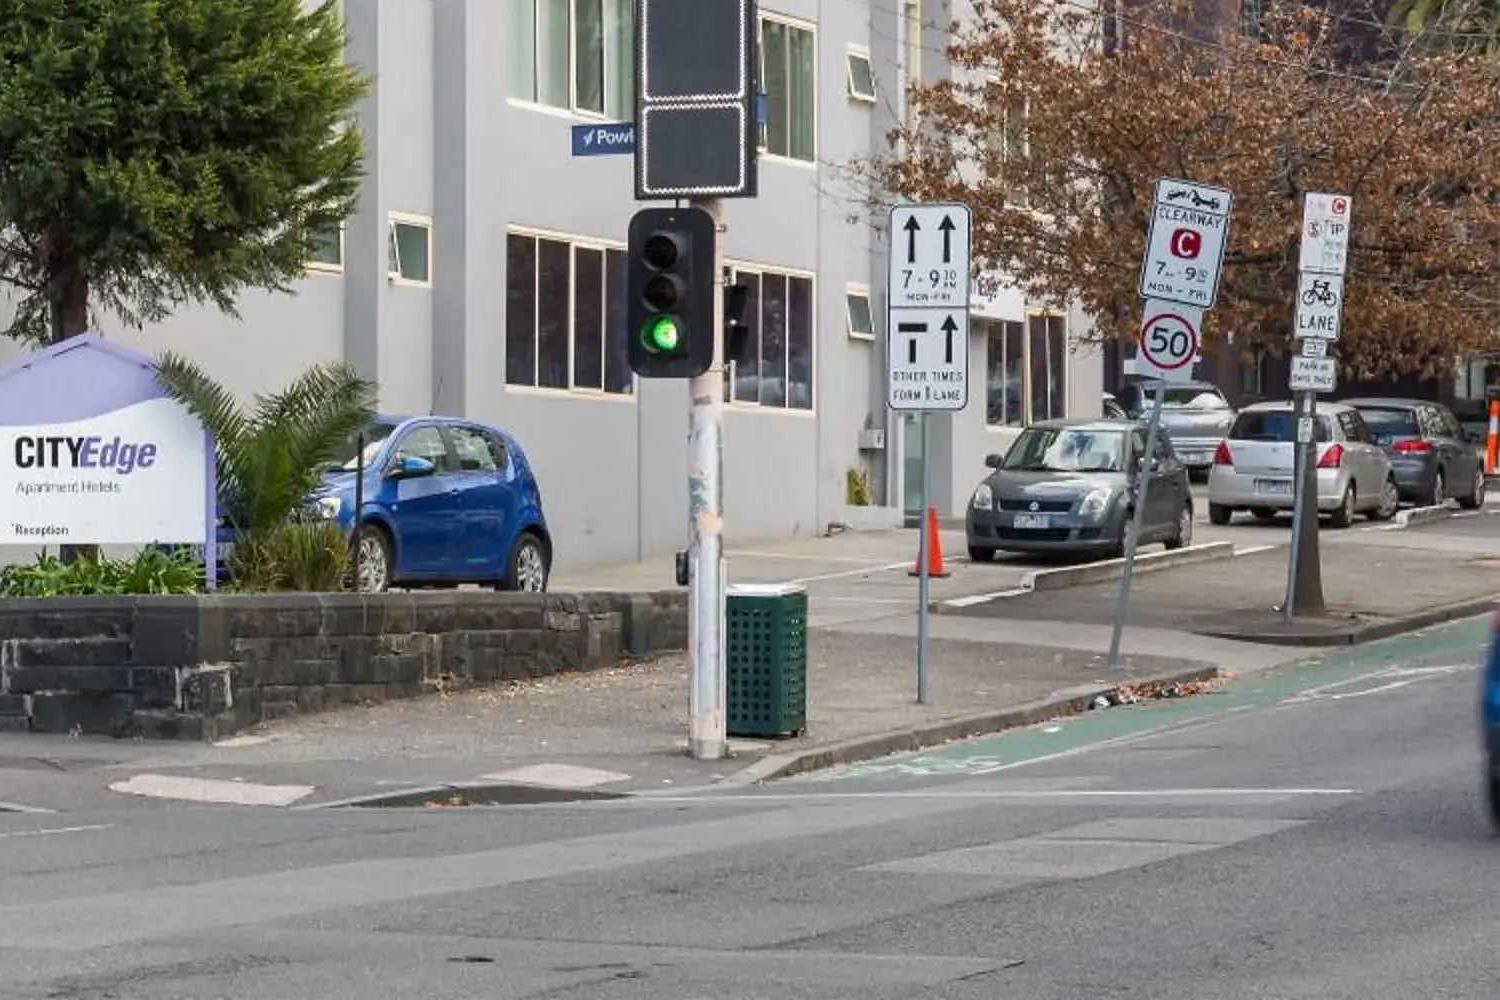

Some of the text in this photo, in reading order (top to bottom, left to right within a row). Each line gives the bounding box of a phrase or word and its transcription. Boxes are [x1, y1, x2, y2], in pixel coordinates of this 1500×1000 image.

[1159, 206, 1222, 228] CLEARWAY
[1177, 230, 1195, 258] C
[1148, 282, 1173, 294] MON
[1189, 286, 1208, 300] FRI
[1300, 314, 1334, 331] LANE
[1150, 327, 1189, 358] 50
[893, 371, 963, 381] OTHER TIMES
[893, 389, 920, 400] FORM
[933, 390, 961, 400] LANE
[16, 481, 120, 496] Apartment Hotels
[14, 523, 68, 536] Reception
